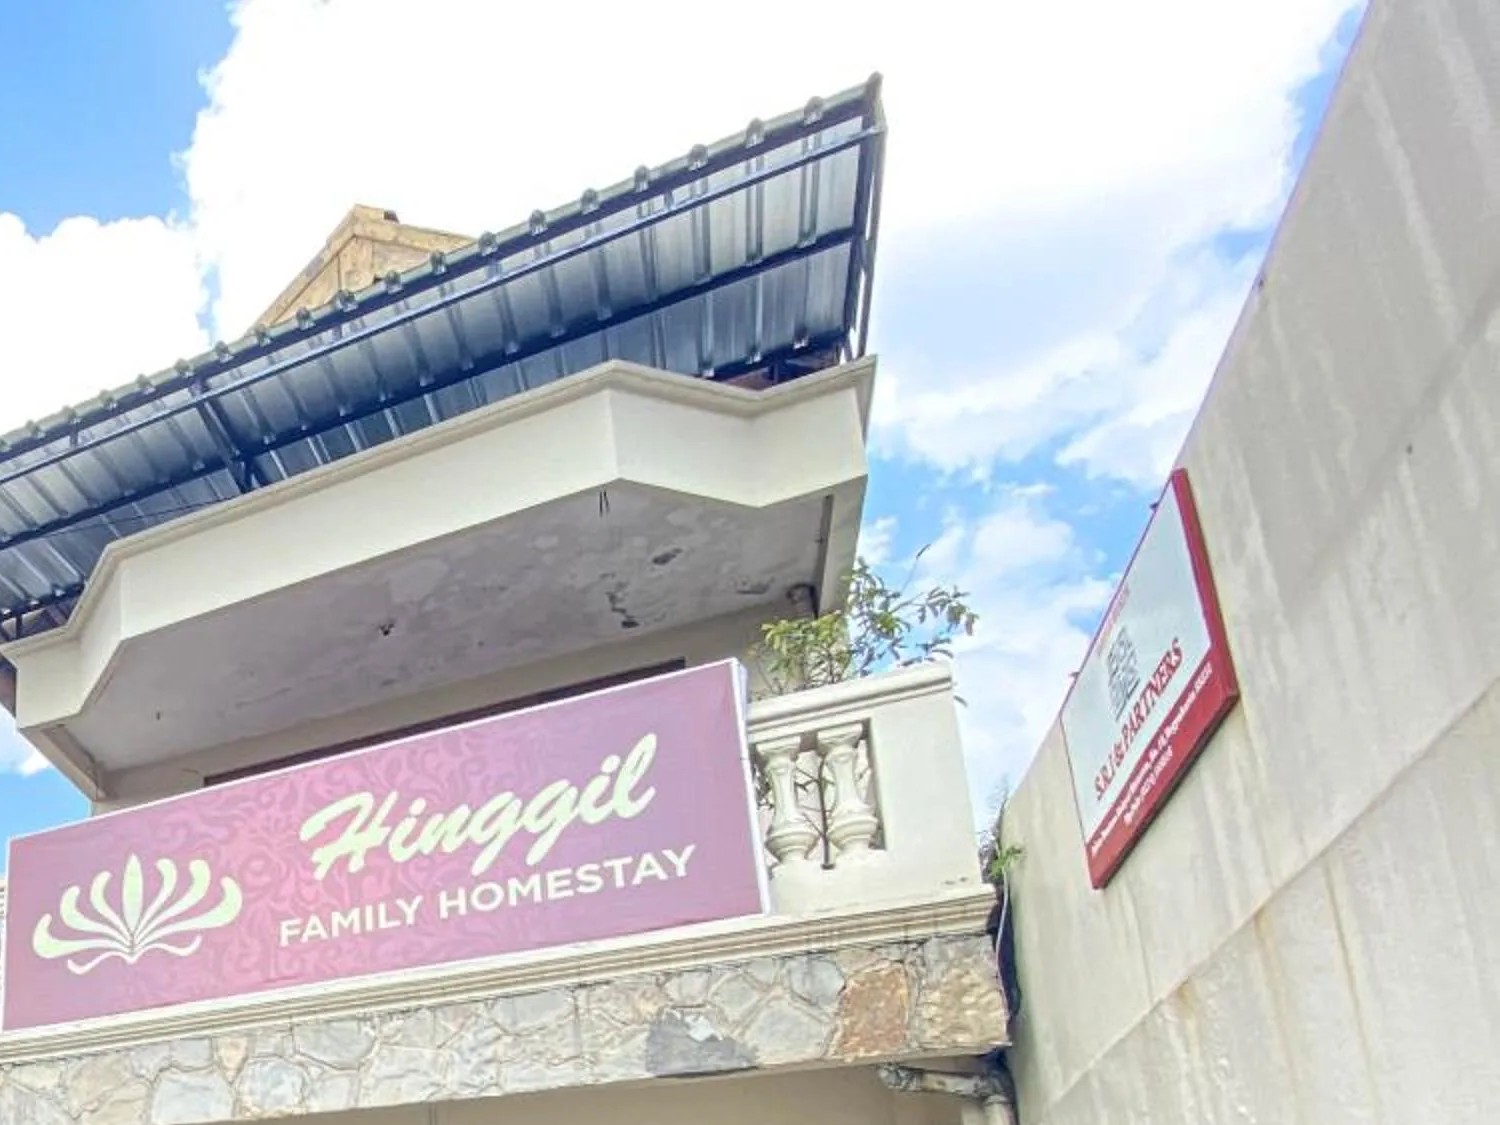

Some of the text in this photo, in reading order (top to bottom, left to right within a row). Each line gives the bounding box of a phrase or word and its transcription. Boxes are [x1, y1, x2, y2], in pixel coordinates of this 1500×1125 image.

[1122, 636, 1183, 751] PARTNERS
[299, 733, 658, 881] Hinggil
[279, 844, 696, 946] FAMILY HOMESTAY
